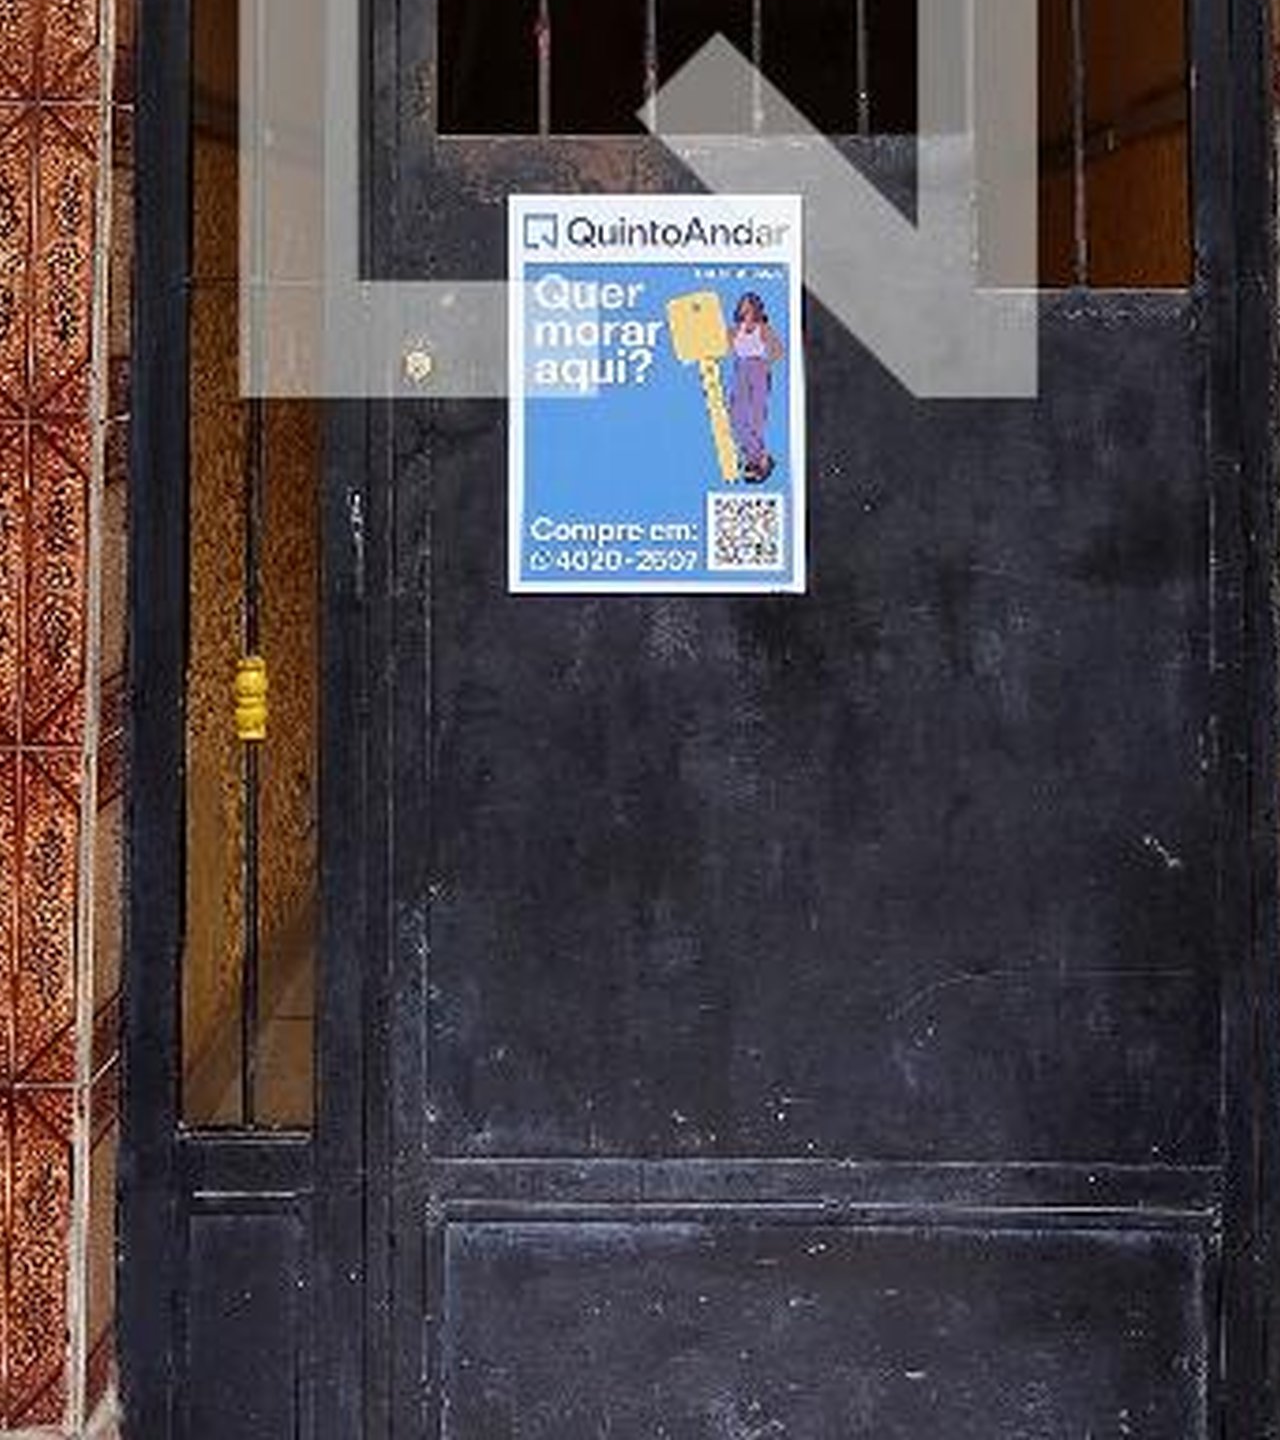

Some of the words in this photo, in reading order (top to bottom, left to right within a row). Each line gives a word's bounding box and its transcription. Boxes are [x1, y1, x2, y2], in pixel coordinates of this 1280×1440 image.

[566, 216, 790, 248] QuintoAndar
[534, 273, 644, 310] Quer
[534, 319, 664, 347] morar
[534, 350, 653, 394] aqui?
[530, 516, 646, 548] Compre
[650, 523, 699, 542] em:
